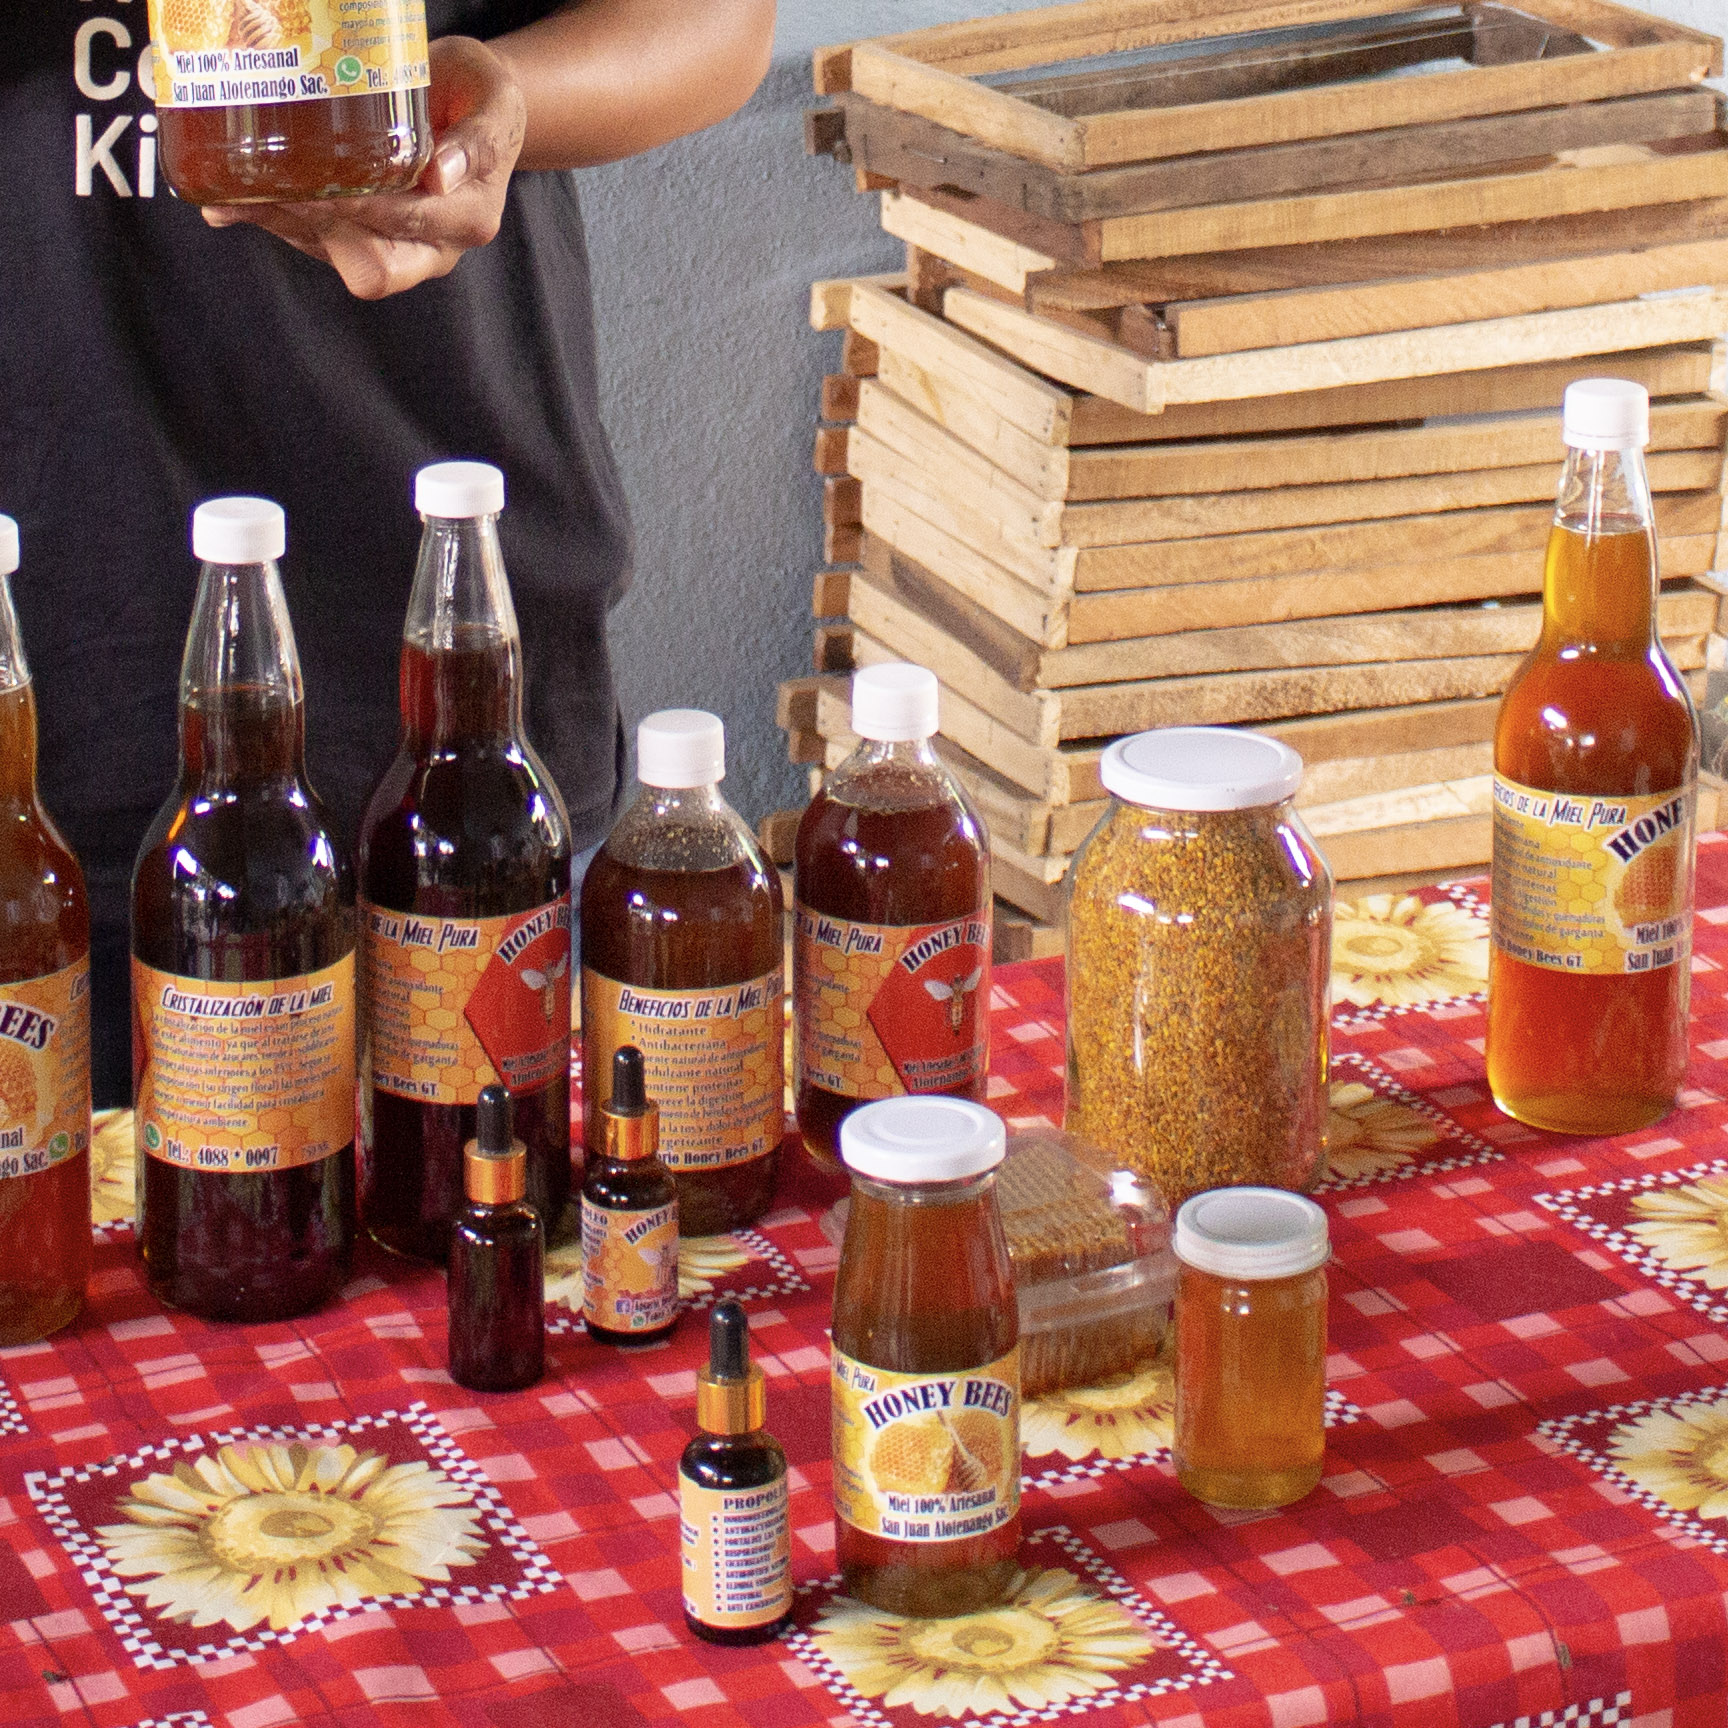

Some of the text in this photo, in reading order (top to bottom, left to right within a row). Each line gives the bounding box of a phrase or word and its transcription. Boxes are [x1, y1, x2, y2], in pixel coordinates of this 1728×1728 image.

[176, 48, 299, 74] Miel 100% Artesanal
[173, 74, 329, 104] San Juan Alotenango Sac.
[1532, 800, 1547, 818] LA
[902, 924, 963, 972] HONEY
[289, 992, 306, 1013] LA
[694, 999, 713, 1018] DE
[716, 996, 733, 1017] LA
[639, 1022, 707, 1037] Hidratante
[639, 1037, 726, 1051] Antibacteriana
[197, 1146, 229, 1165] 4088
[245, 1145, 278, 1167] 0097
[864, 1379, 1012, 1429] HONEY BEES
[888, 1495, 910, 1513] Miel
[914, 1496, 946, 1515] 100%
[881, 1516, 900, 1536] San
[903, 1518, 930, 1539] Juan
